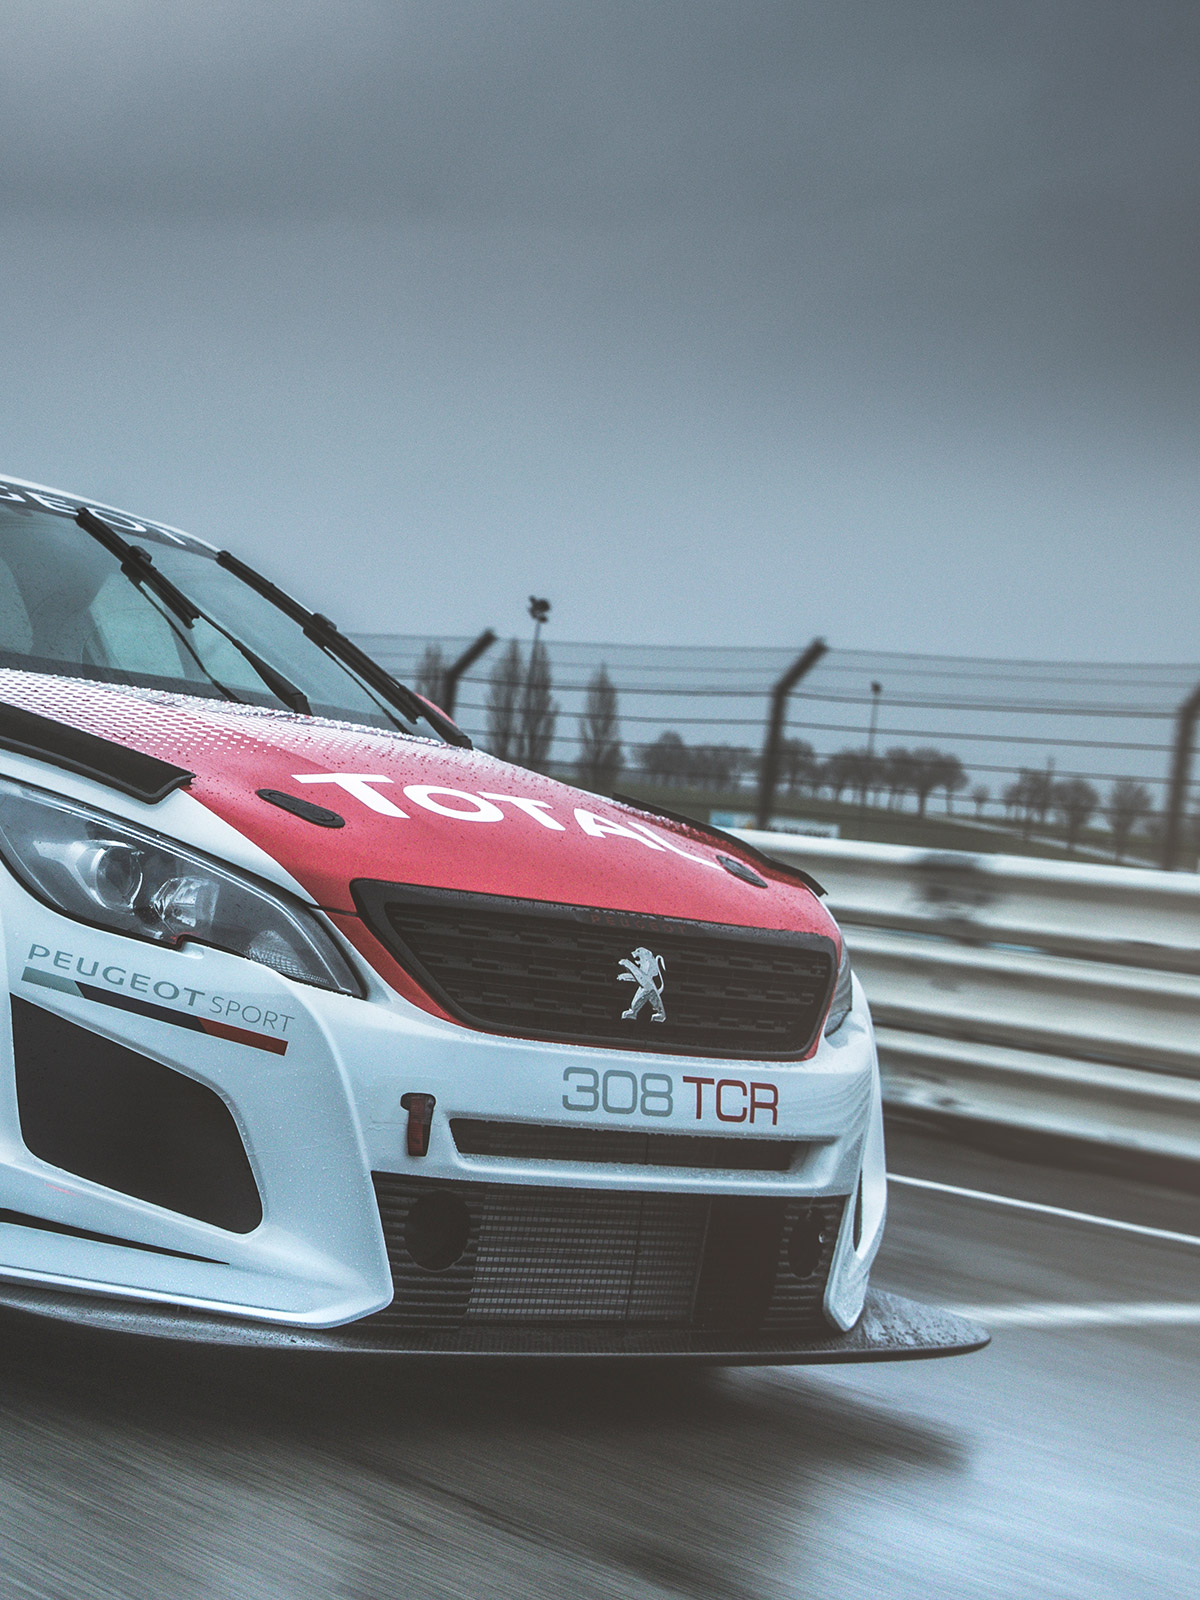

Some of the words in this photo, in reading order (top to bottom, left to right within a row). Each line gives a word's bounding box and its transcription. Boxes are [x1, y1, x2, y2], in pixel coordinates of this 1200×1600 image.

[290, 772, 727, 872] TOTAL
[589, 913, 687, 935] PEUGEOT
[27, 943, 205, 1008] PEUGEOT
[208, 995, 296, 1033] SPORT
[562, 1066, 674, 1118] 308
[682, 1075, 779, 1126] TCR
